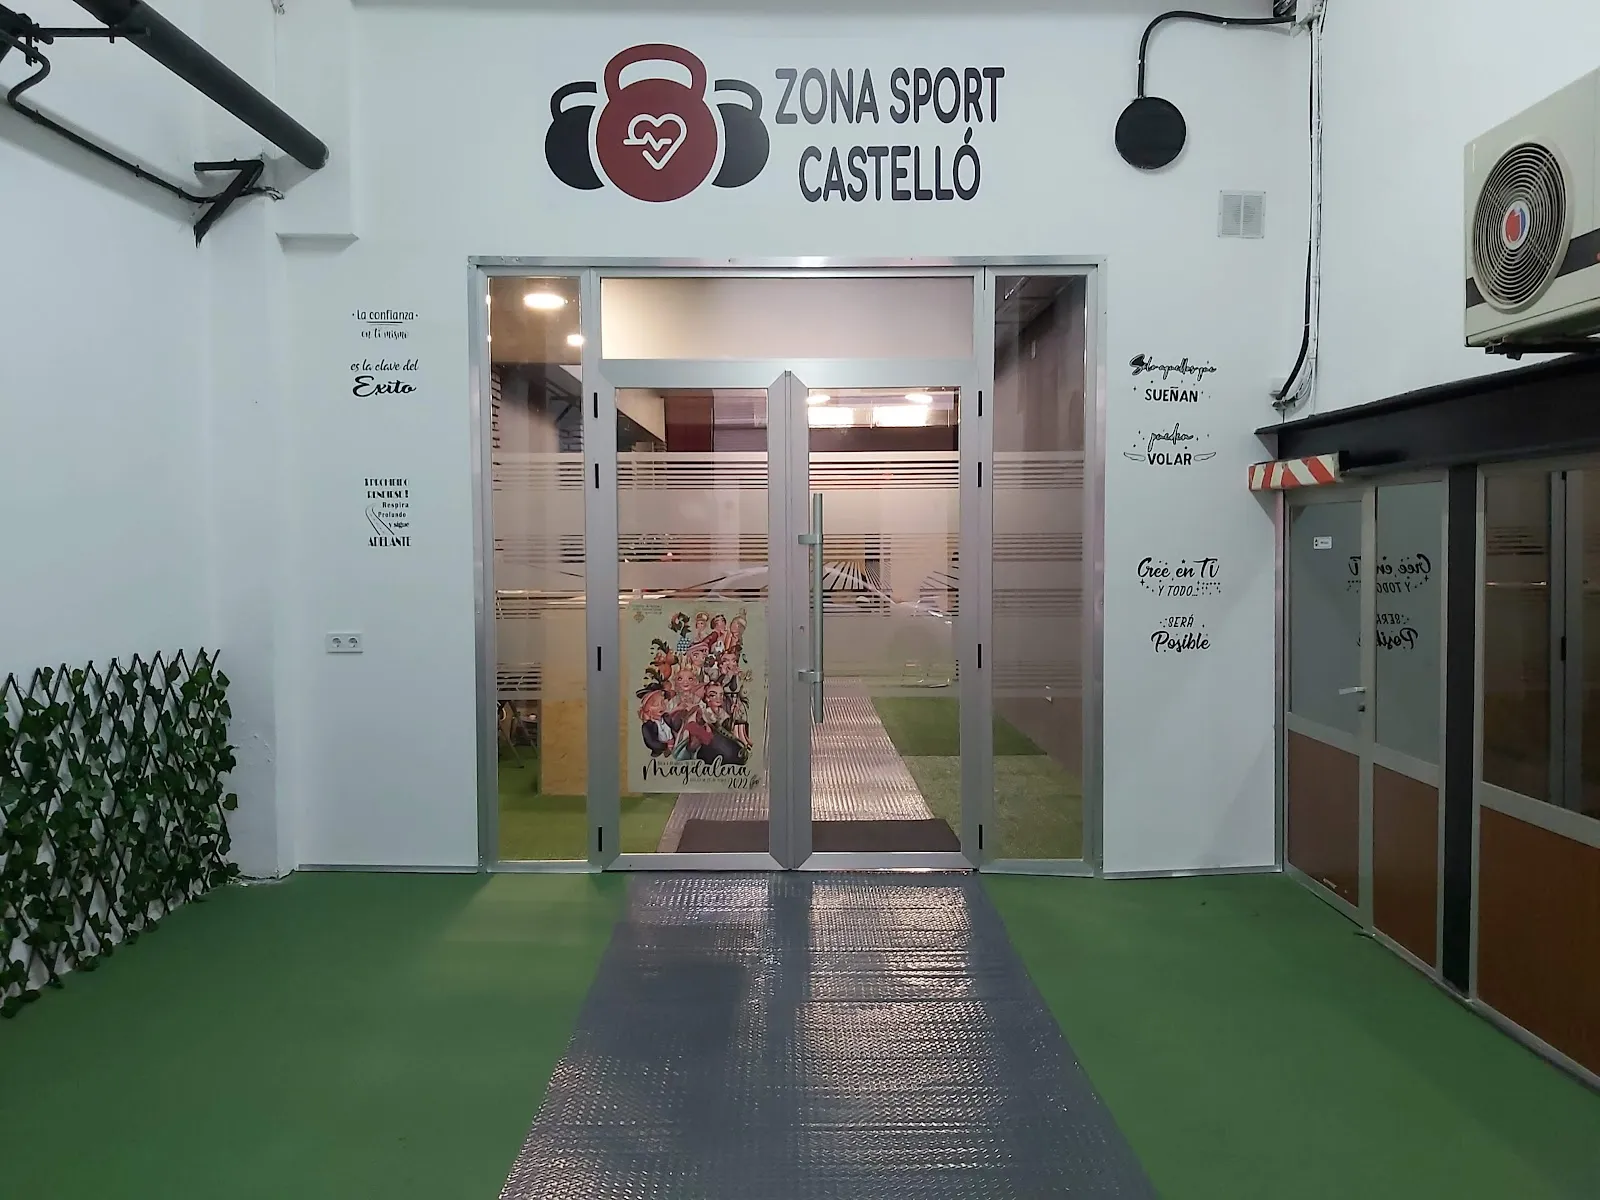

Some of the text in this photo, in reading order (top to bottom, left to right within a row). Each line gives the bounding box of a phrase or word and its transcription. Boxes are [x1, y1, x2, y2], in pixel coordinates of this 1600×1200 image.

[775, 67, 1005, 125] ZONA SPORT
[798, 126, 981, 202] CASTELLÓ
[369, 309, 414, 320] confianza
[350, 358, 419, 372] es la clave del
[352, 375, 417, 398] Exito
[1144, 386, 1198, 403] SUEÑAN
[1147, 453, 1192, 466] VOLAR
[382, 501, 409, 509] Respira
[393, 521, 410, 529] sigue
[1137, 557, 1170, 578] Cree
[1175, 567, 1195, 578] en
[1158, 585, 1164, 597] Y
[1168, 614, 1194, 628] SERÁ
[1150, 630, 1211, 653] Posible
[643, 755, 751, 785] Magdalena
